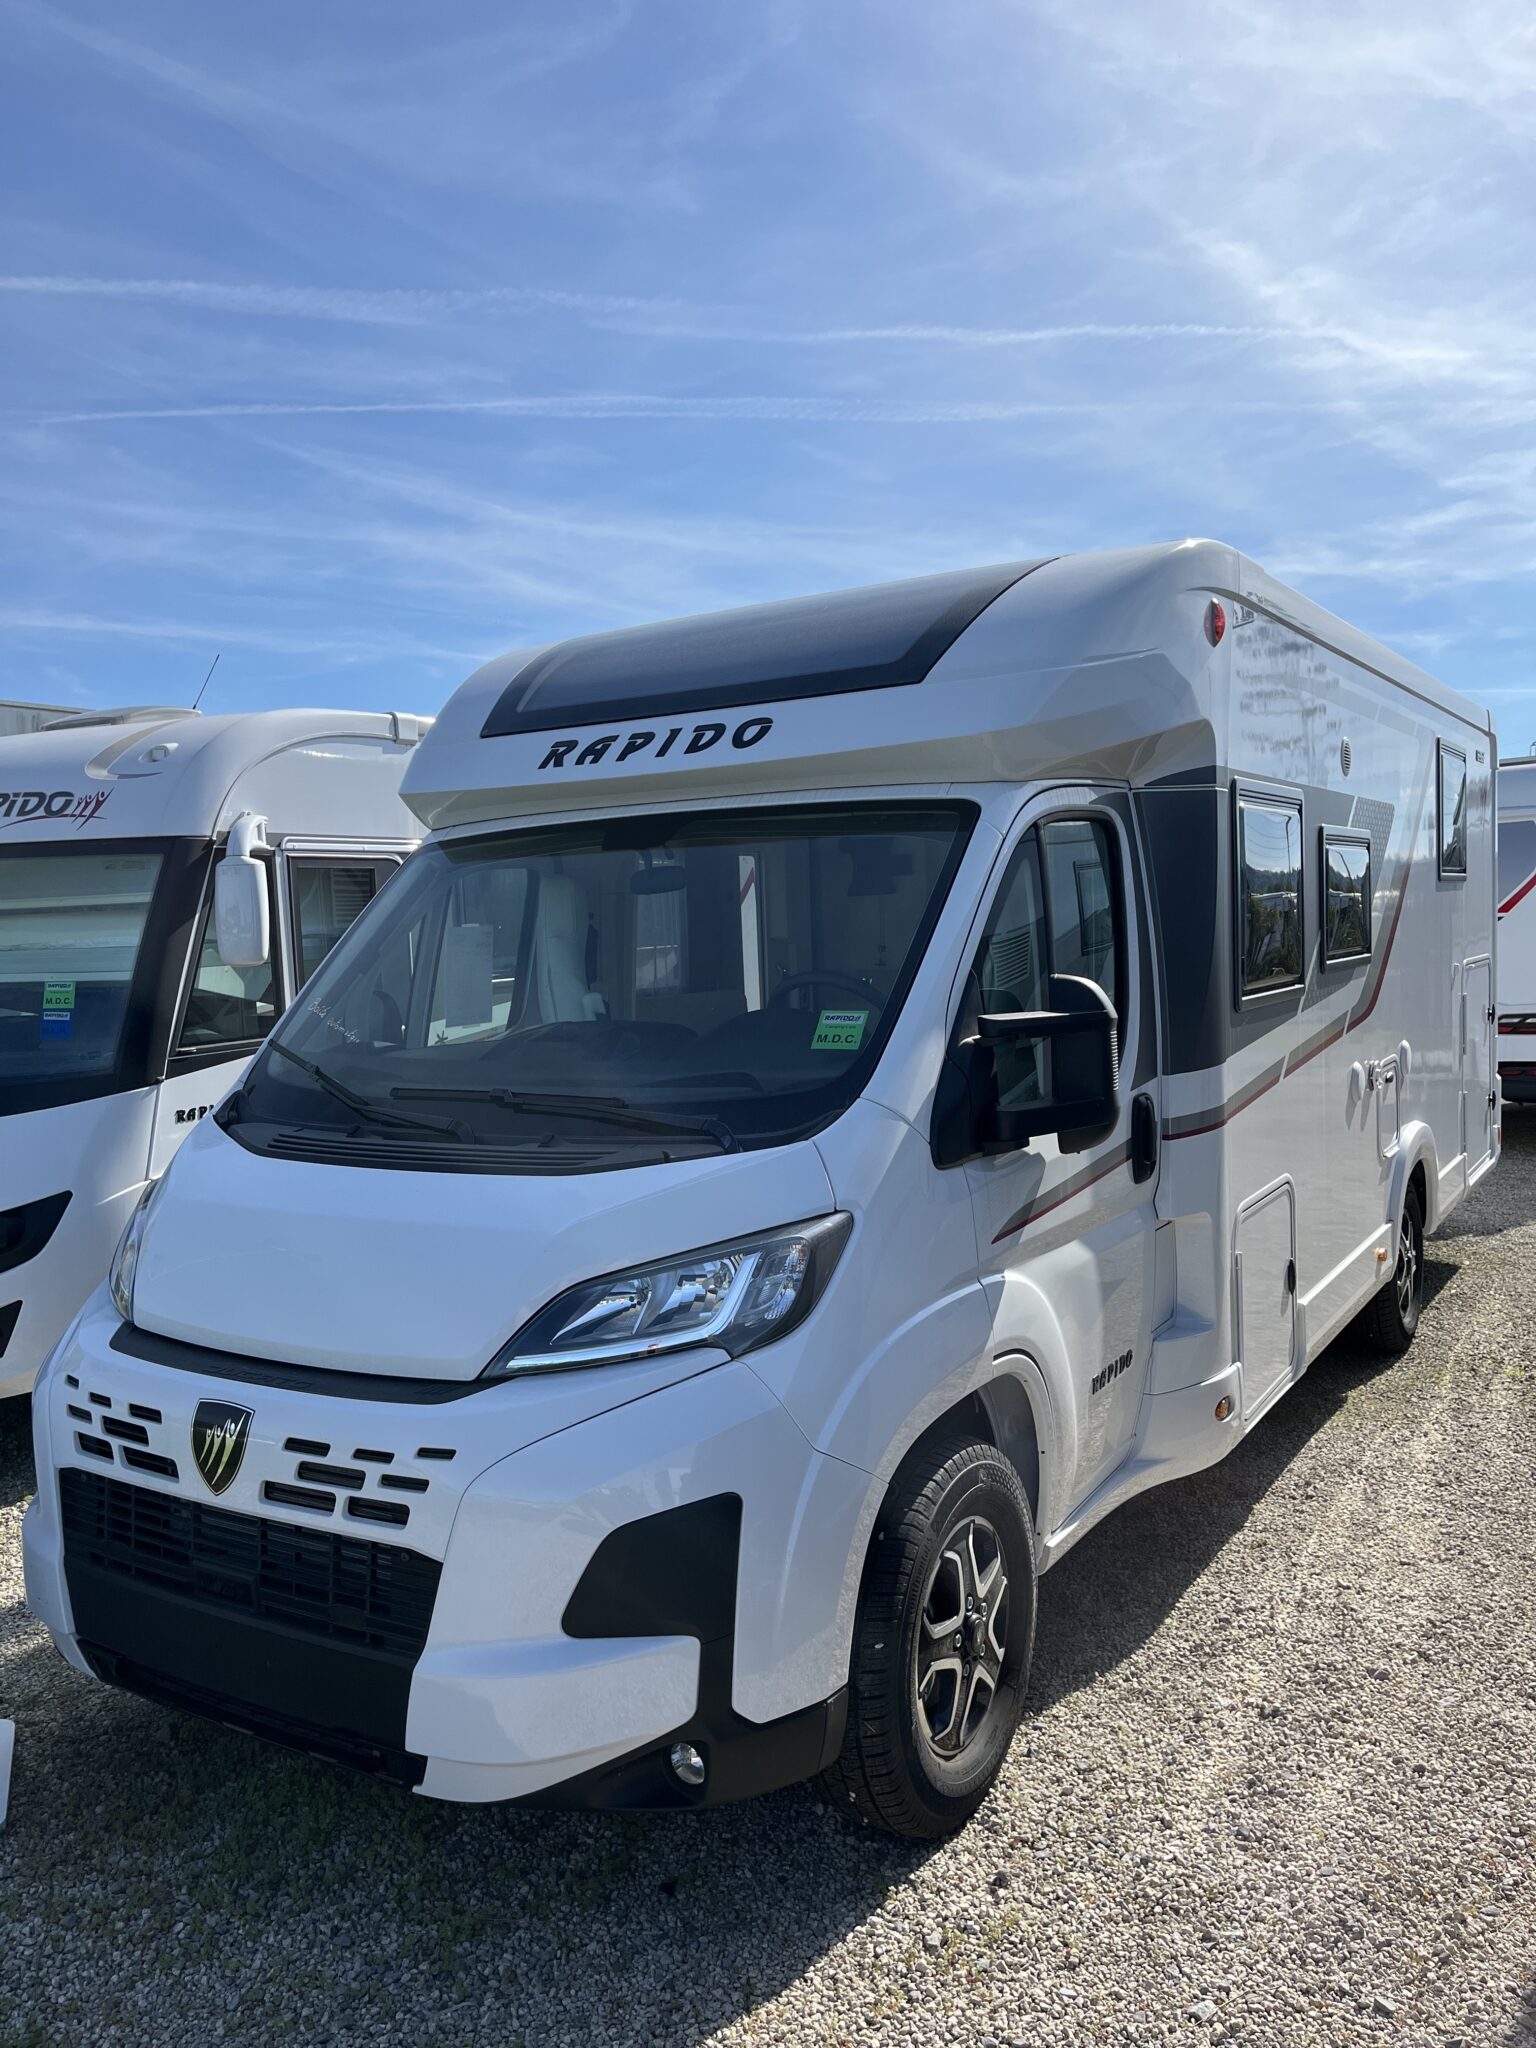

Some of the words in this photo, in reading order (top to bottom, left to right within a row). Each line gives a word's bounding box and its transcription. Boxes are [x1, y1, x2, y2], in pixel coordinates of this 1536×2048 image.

[537, 717, 774, 769] RAPIDO
[816, 1034, 857, 1043] M.D.C.
[1092, 1349, 1133, 1395] RAPIDO
